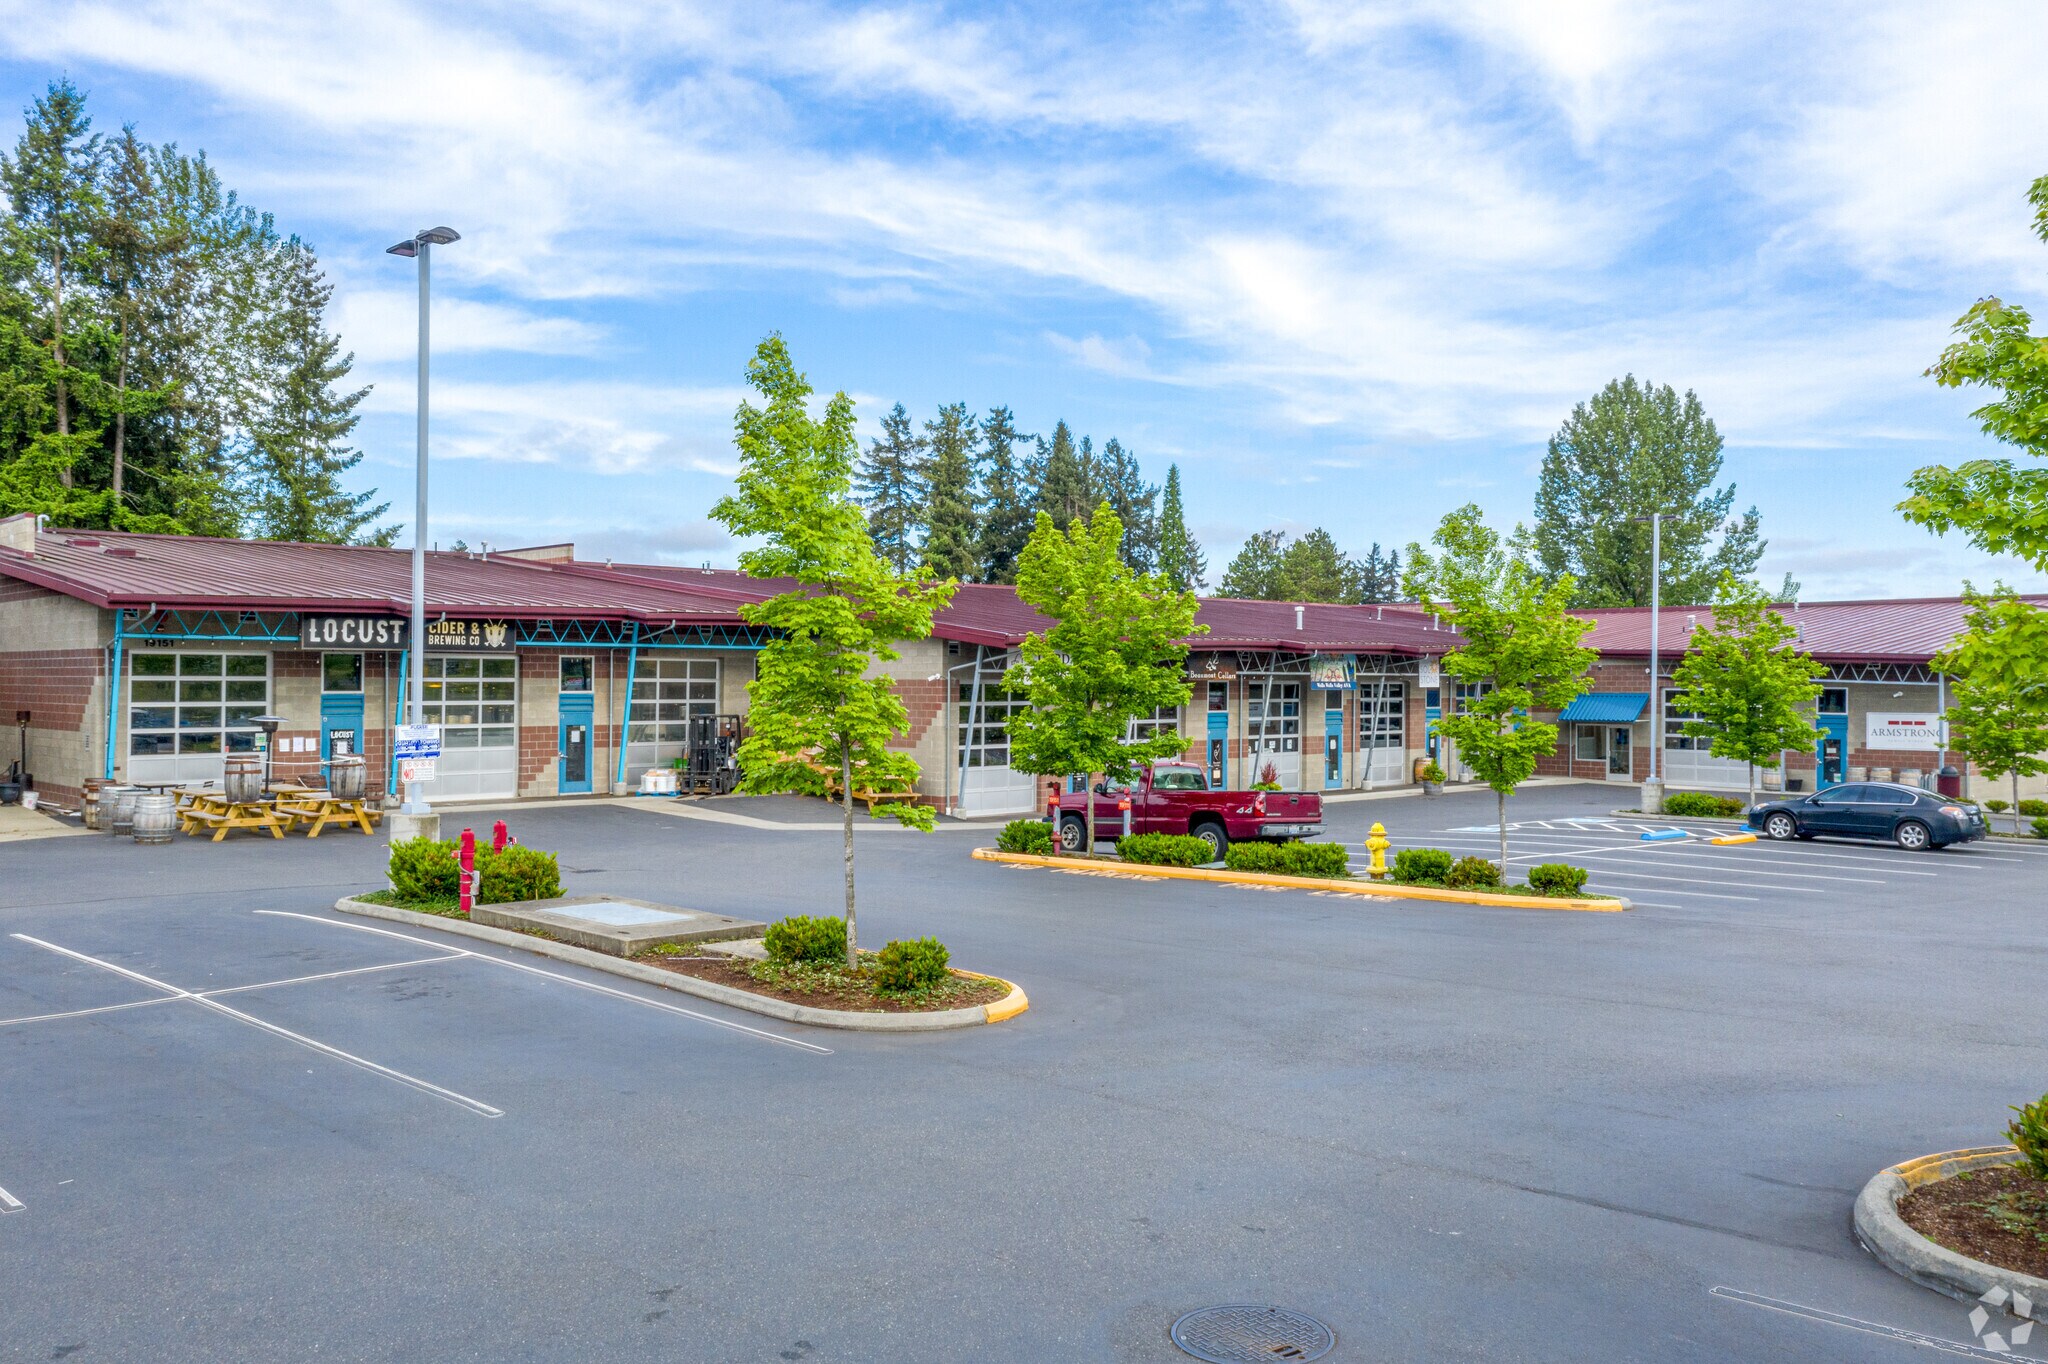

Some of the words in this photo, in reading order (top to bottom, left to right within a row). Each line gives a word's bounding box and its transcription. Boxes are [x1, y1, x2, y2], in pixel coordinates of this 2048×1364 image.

[308, 618, 405, 643] LOCUST
[428, 621, 465, 634] CIDER
[471, 622, 479, 635] &
[144, 639, 174, 647] 19151
[428, 635, 466, 645] BREWING
[469, 635, 480, 645] CO
[1190, 670, 1216, 678] Beaumont
[1217, 670, 1236, 679] Cellars
[330, 731, 354, 739] LOCUST
